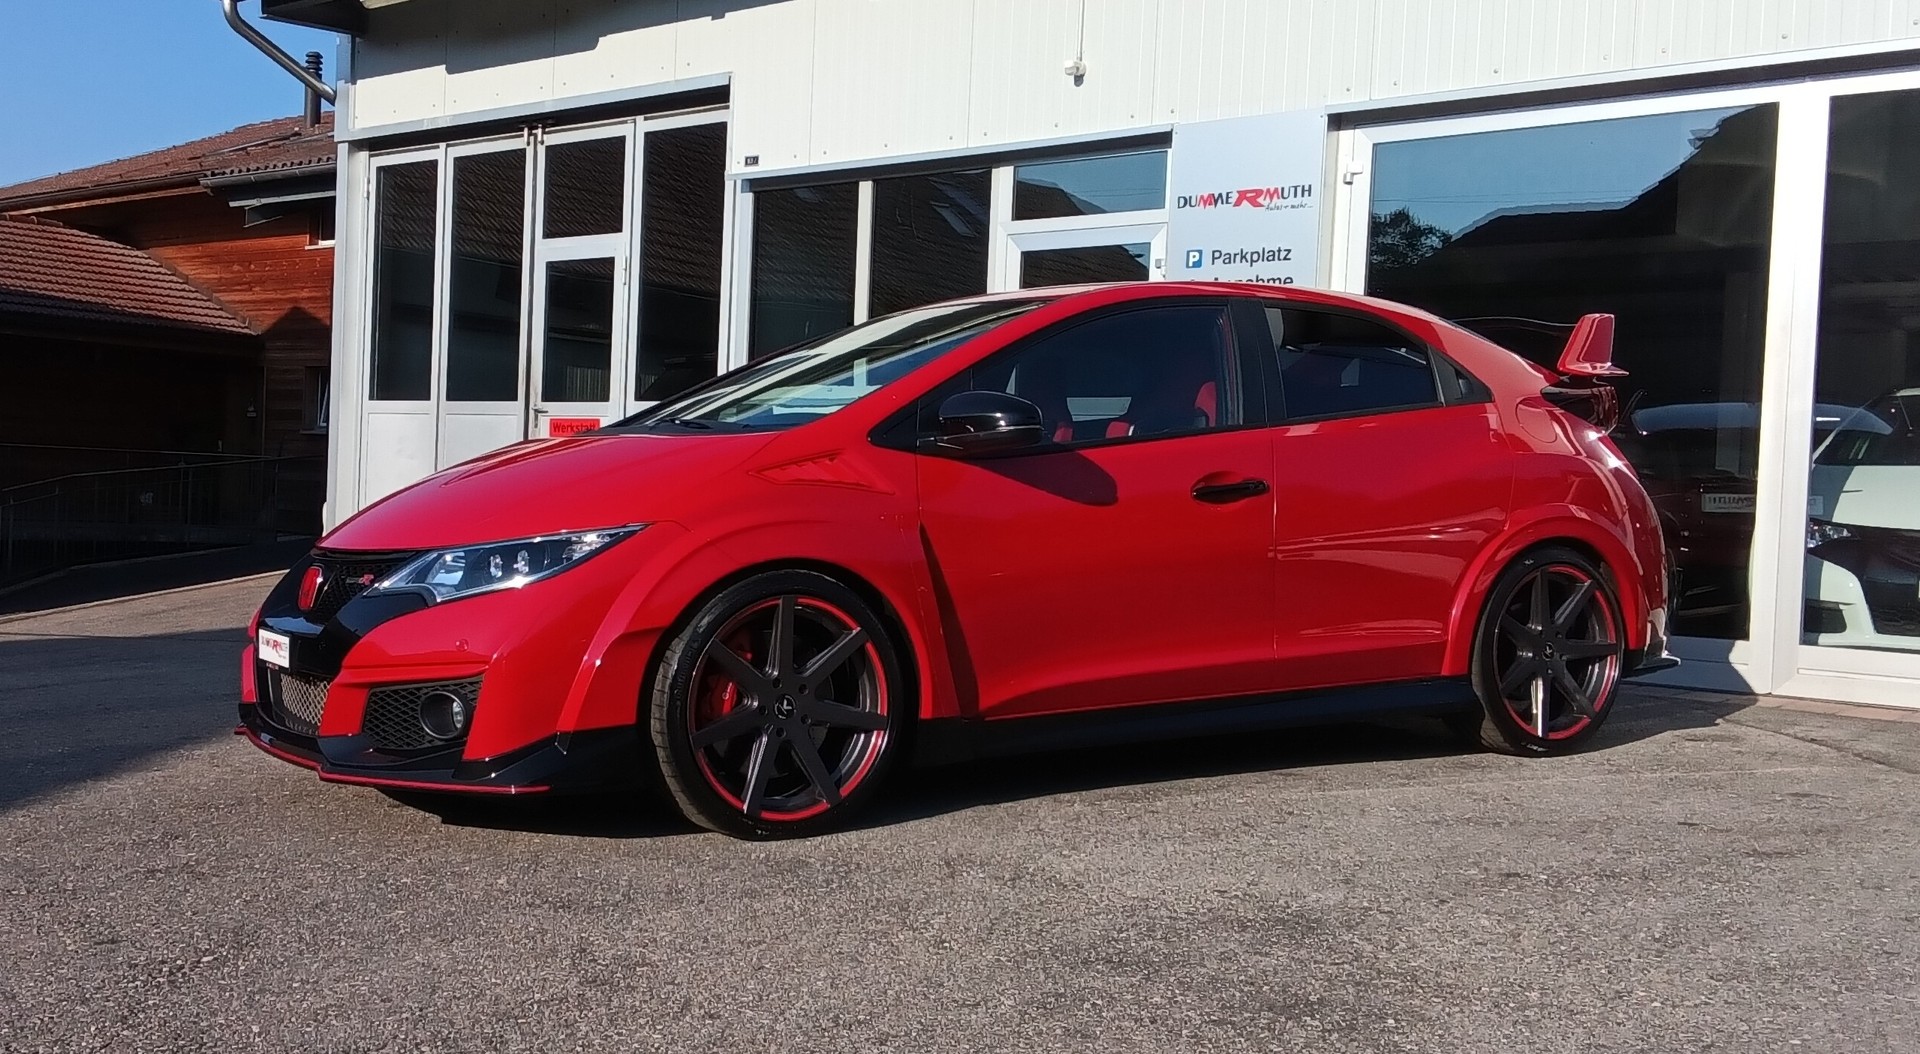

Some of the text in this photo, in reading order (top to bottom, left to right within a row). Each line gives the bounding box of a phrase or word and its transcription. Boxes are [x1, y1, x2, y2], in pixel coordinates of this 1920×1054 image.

[1177, 184, 1312, 209] DUMMERMUTH
[1211, 246, 1292, 267] Parkplatz
[553, 421, 596, 433] Werkstatt
